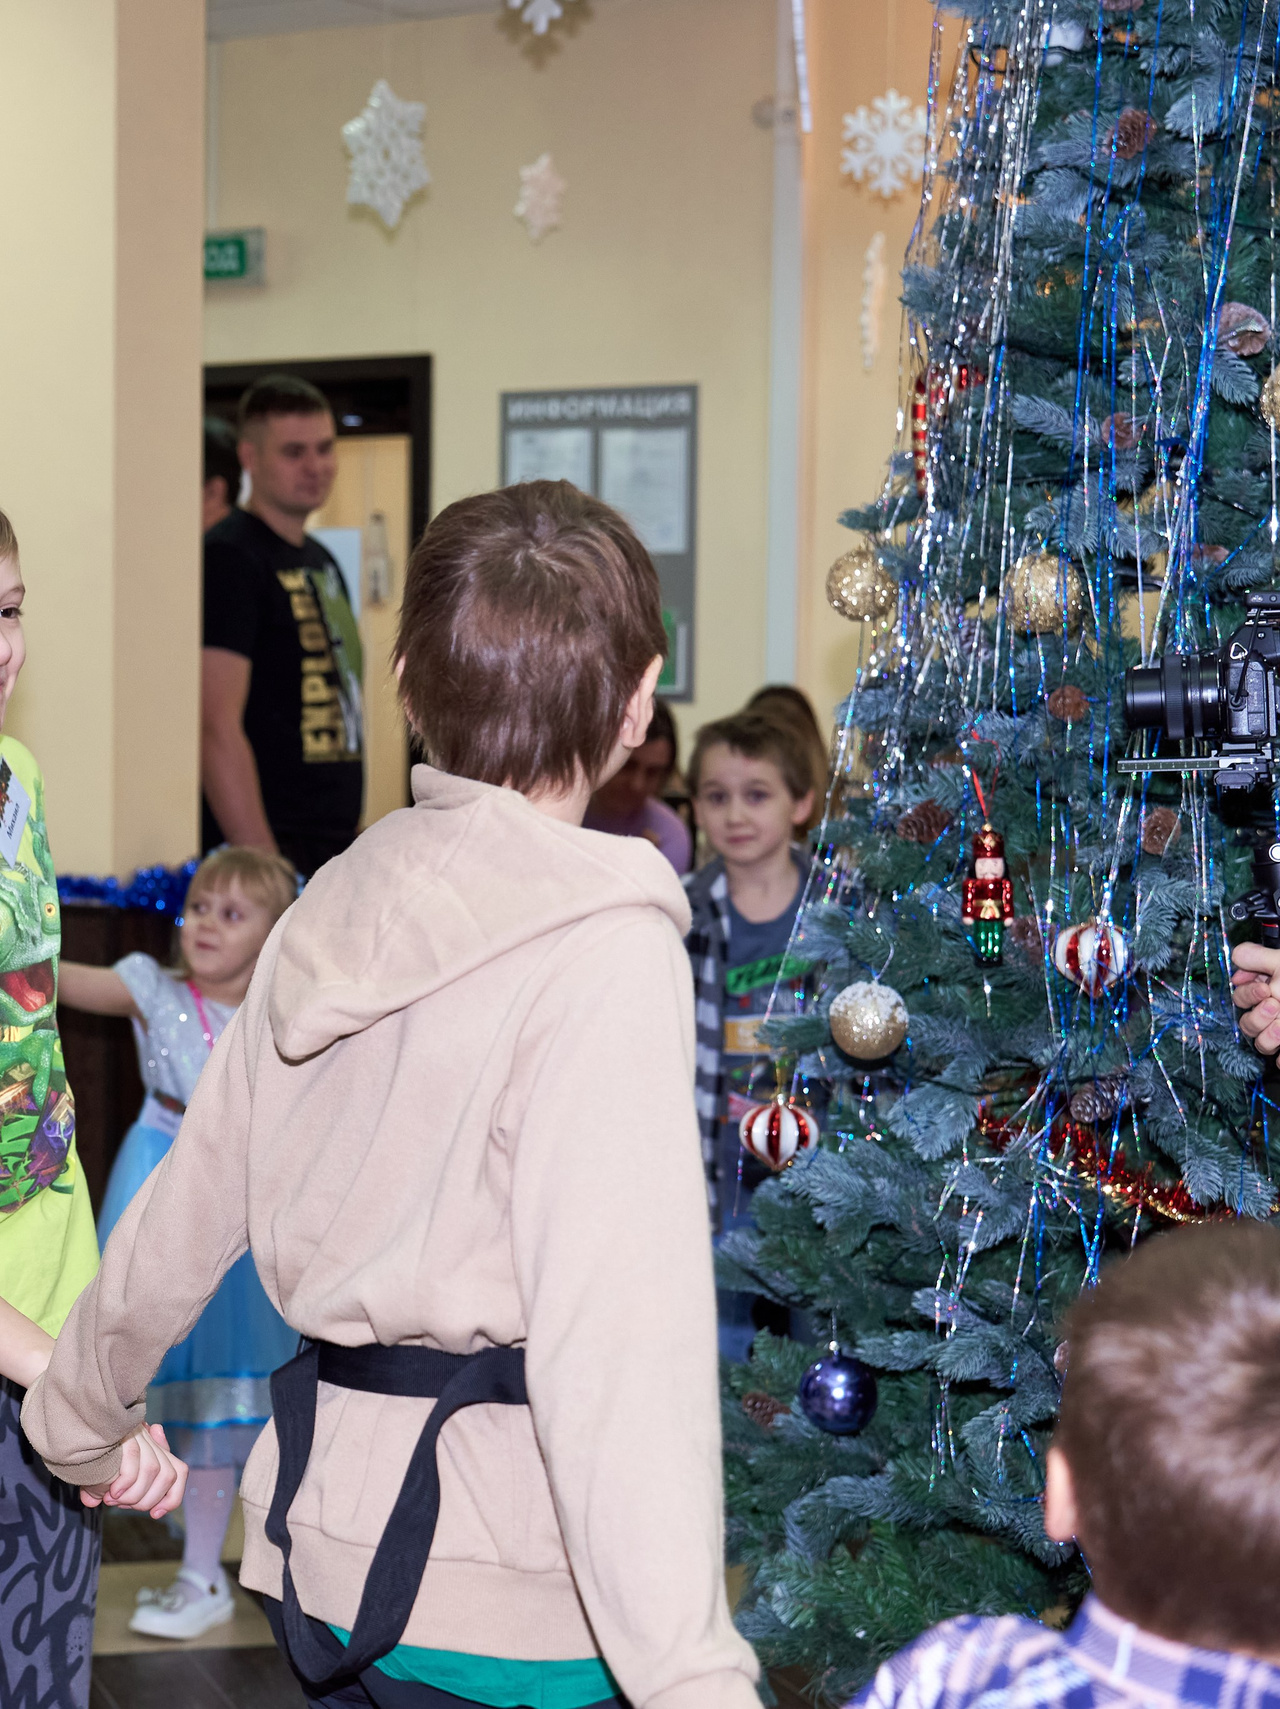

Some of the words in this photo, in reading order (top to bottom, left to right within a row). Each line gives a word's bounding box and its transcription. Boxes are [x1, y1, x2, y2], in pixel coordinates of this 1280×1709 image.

[204, 246, 239, 271] ОД
[507, 393, 691, 422] ИНФОРМАЦИЯ
[6, 803, 21, 839] Михаил
